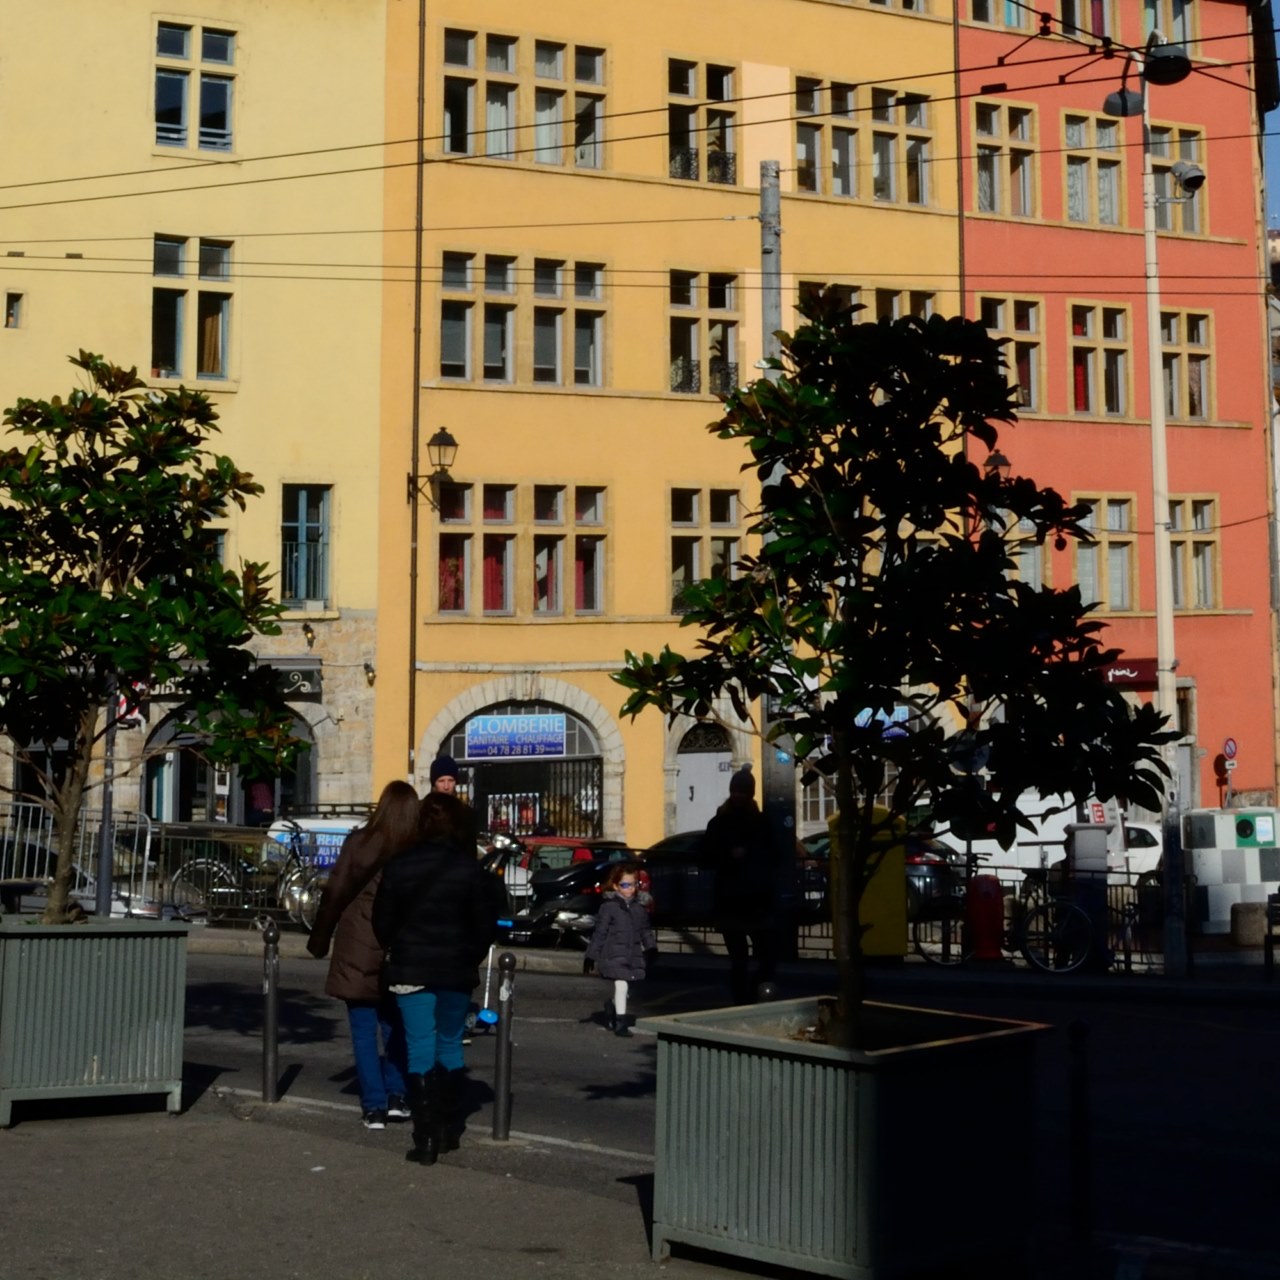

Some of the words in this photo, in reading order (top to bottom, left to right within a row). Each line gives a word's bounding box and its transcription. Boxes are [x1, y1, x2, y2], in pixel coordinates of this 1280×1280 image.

[468, 717, 564, 735] PLOMBERIE
[468, 735, 509, 746] SANITAIRE
[515, 733, 564, 745] CHAUFFAGE
[487, 745, 498, 755] 04
